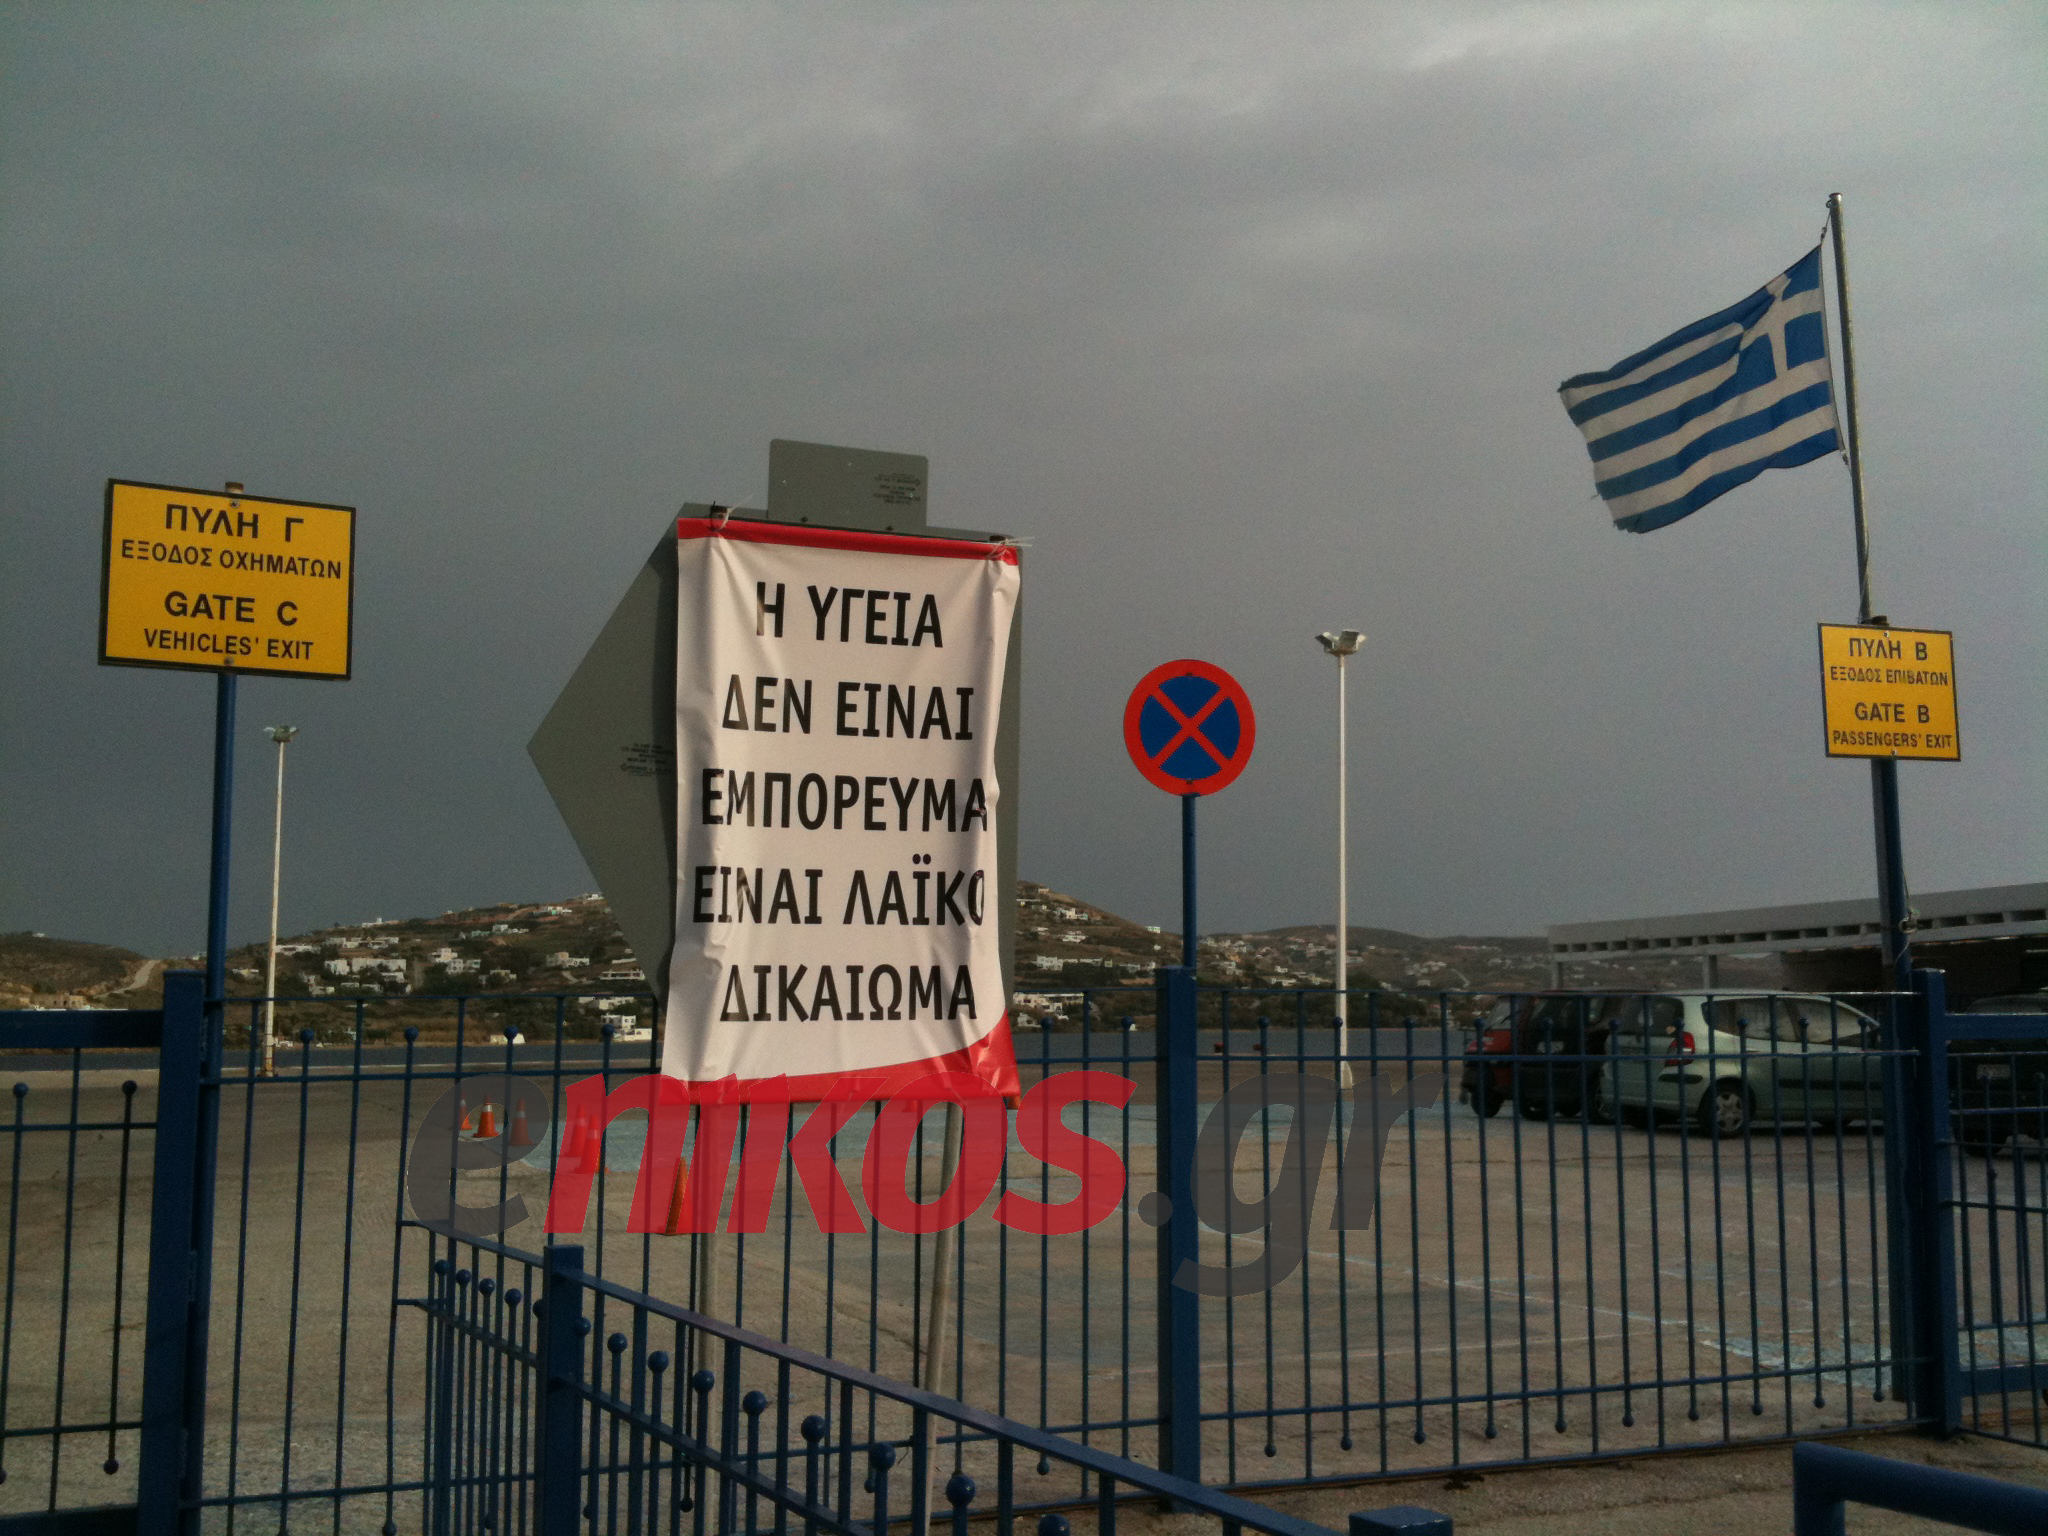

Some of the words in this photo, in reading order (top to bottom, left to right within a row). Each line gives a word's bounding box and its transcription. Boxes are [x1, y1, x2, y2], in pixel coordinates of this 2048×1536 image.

[165, 503, 259, 539] ΠΥΛΗ
[285, 517, 304, 542] Γ
[121, 538, 213, 567] ΕΞΟΔΟΣ
[219, 549, 342, 579] ΟΧΗΜΑΤΩΝ
[164, 590, 256, 624] GATE
[276, 601, 299, 626] C
[756, 581, 785, 638] Η
[807, 585, 943, 648] ΥΓΕΙΑ
[266, 638, 314, 660] EXIT
[1848, 637, 1902, 660] ΠΥΛΗ
[1830, 666, 1882, 683] ΕΞΟΔΟΣ
[1886, 669, 1949, 686] ΕΠΙΒΑΤΩΝ
[721, 673, 812, 735] ΔΕΝ
[836, 681, 974, 741] ΕΙΝΑΙ
[1854, 702, 1906, 723] GATE
[1917, 704, 1930, 724] B
[1926, 733, 1953, 749] EXIT
[701, 768, 988, 832] ΕΜΠΟΡΕΥΜΑ
[692, 865, 823, 925] ΕΙΝΑΙ
[719, 963, 978, 1022] ΔΙΚΑΙΩΜΑ
